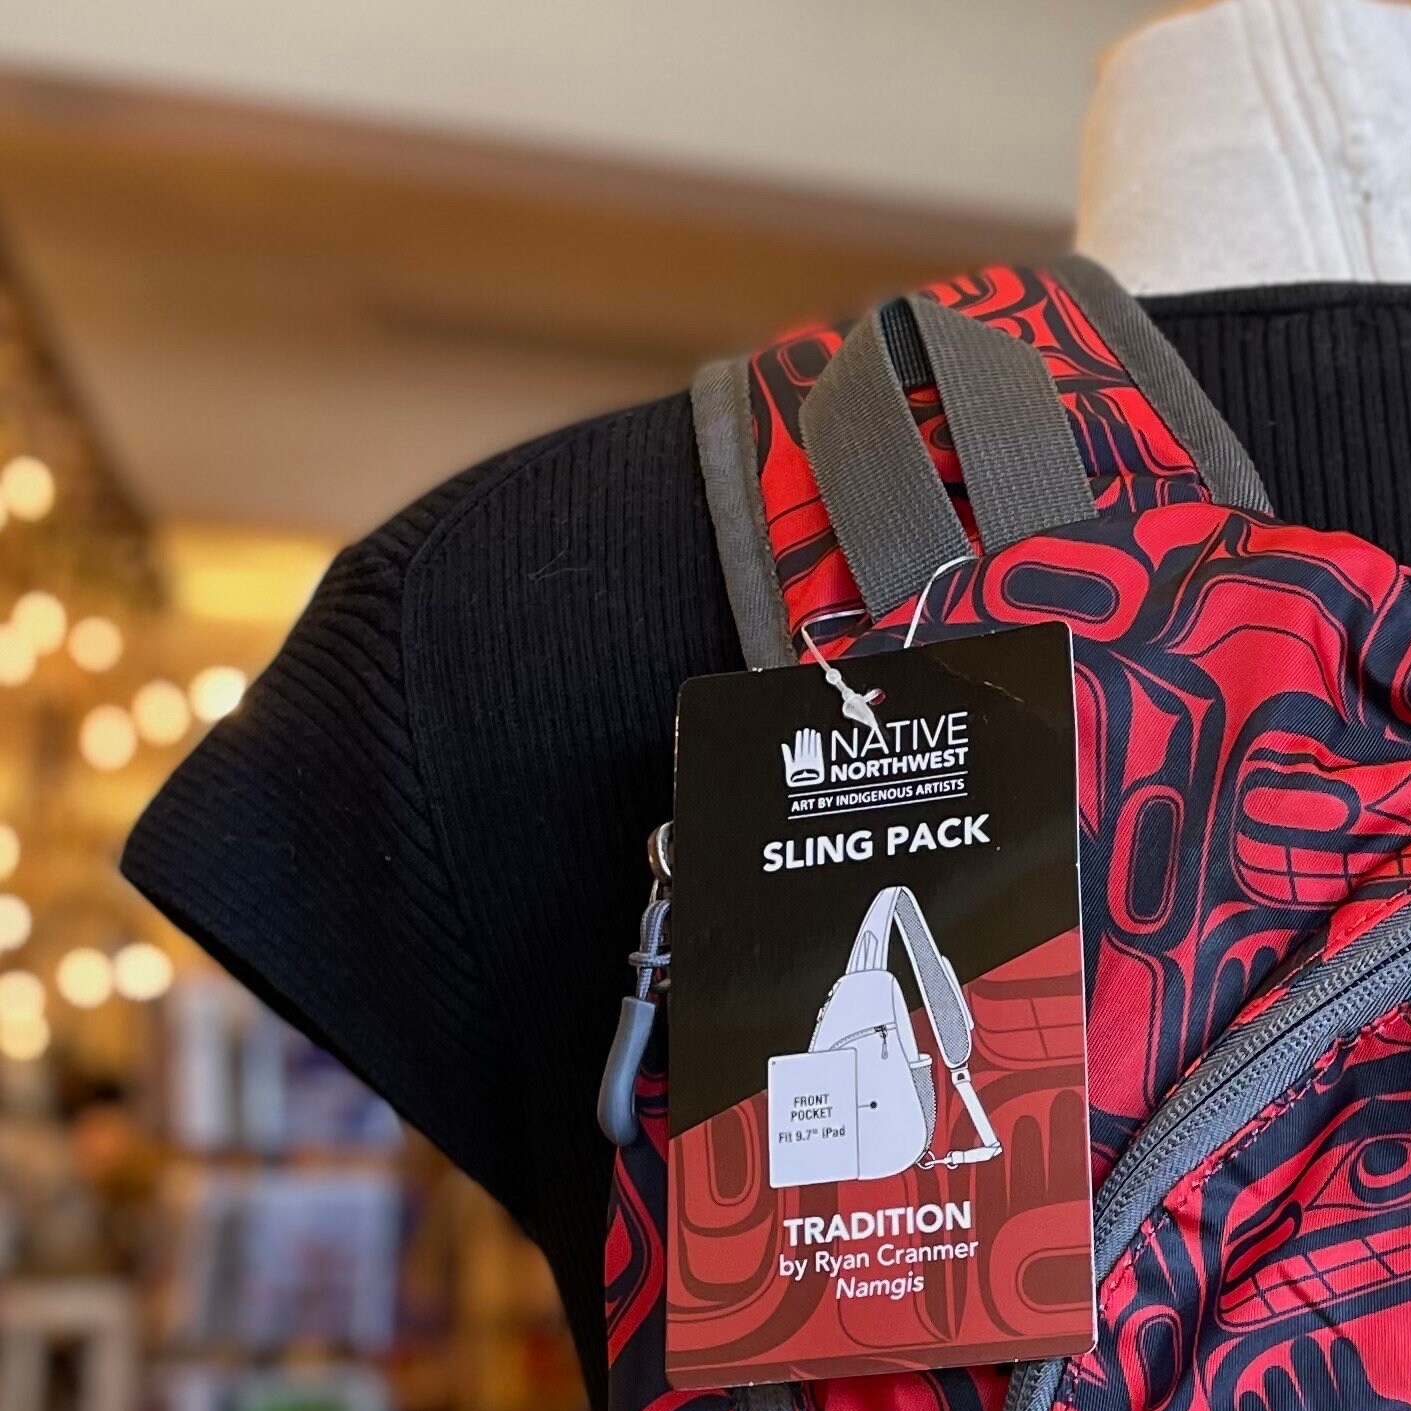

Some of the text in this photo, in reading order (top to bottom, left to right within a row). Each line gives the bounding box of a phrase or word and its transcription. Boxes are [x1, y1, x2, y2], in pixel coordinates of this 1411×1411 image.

[831, 711, 969, 761] NATIVE
[830, 746, 969, 783] NORTHWEST
[791, 778, 965, 813] ART BY INDIGENOUS ARTISTS
[762, 813, 991, 872] SLING PACK
[790, 1106, 833, 1122] POCKET
[793, 1093, 830, 1108] FRONT
[778, 1132, 793, 1144] Fit
[822, 1124, 846, 1139] iPad
[783, 1200, 972, 1247] TRADITION
[779, 1240, 979, 1281] by Ryan Cranmer
[835, 1270, 925, 1300] Namgis
